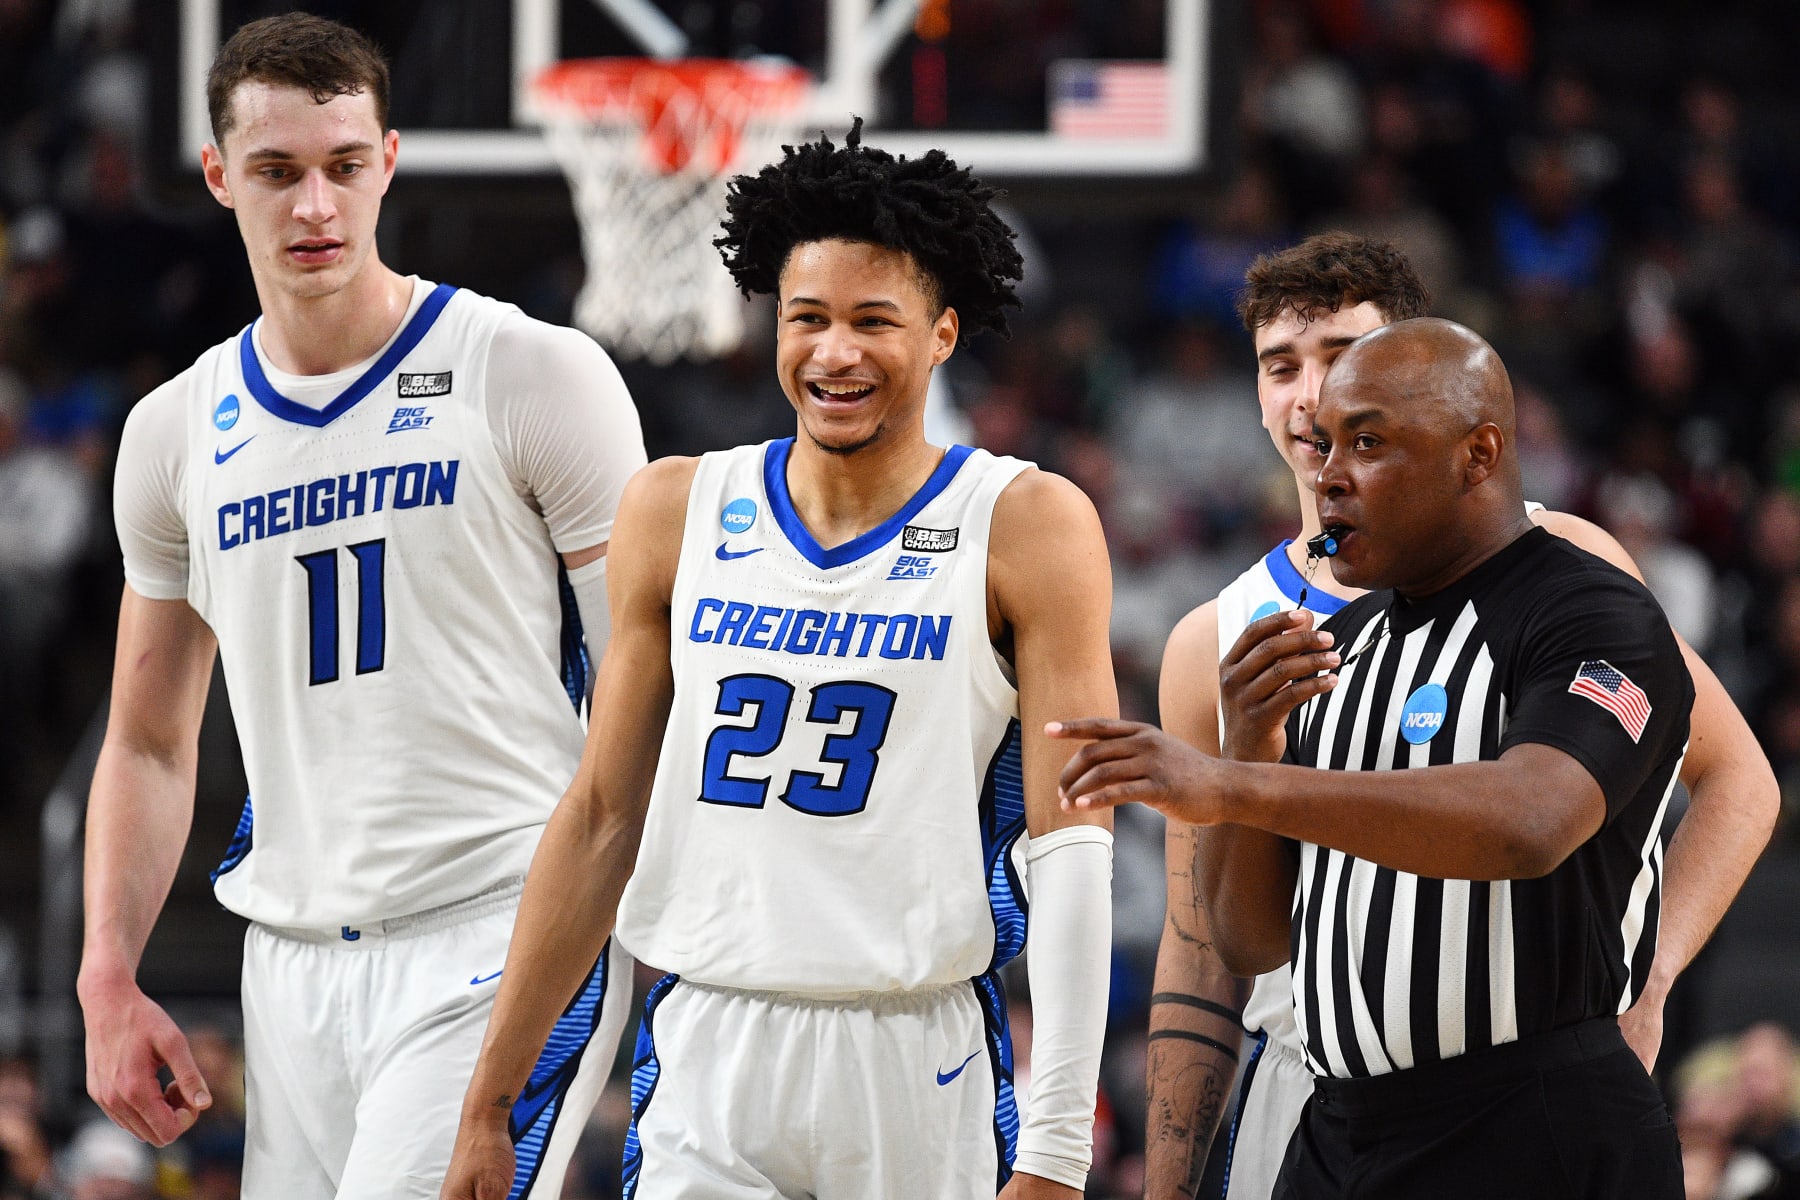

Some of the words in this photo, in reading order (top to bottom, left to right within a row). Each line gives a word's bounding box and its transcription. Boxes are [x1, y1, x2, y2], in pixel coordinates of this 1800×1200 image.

[400, 384, 450, 395] CHANGE
[393, 407, 427, 417] BIG
[388, 416, 434, 428] EAST
[218, 460, 459, 550] CREIGHTON
[724, 513, 753, 525] NCAA
[904, 540, 956, 550] CHANGE
[896, 555, 932, 567] BIG
[890, 565, 939, 577] EAST
[294, 538, 386, 686] 11
[688, 597, 952, 660] CREIGHTON
[1405, 712, 1442, 728] NCAA
[697, 673, 898, 817] 23
